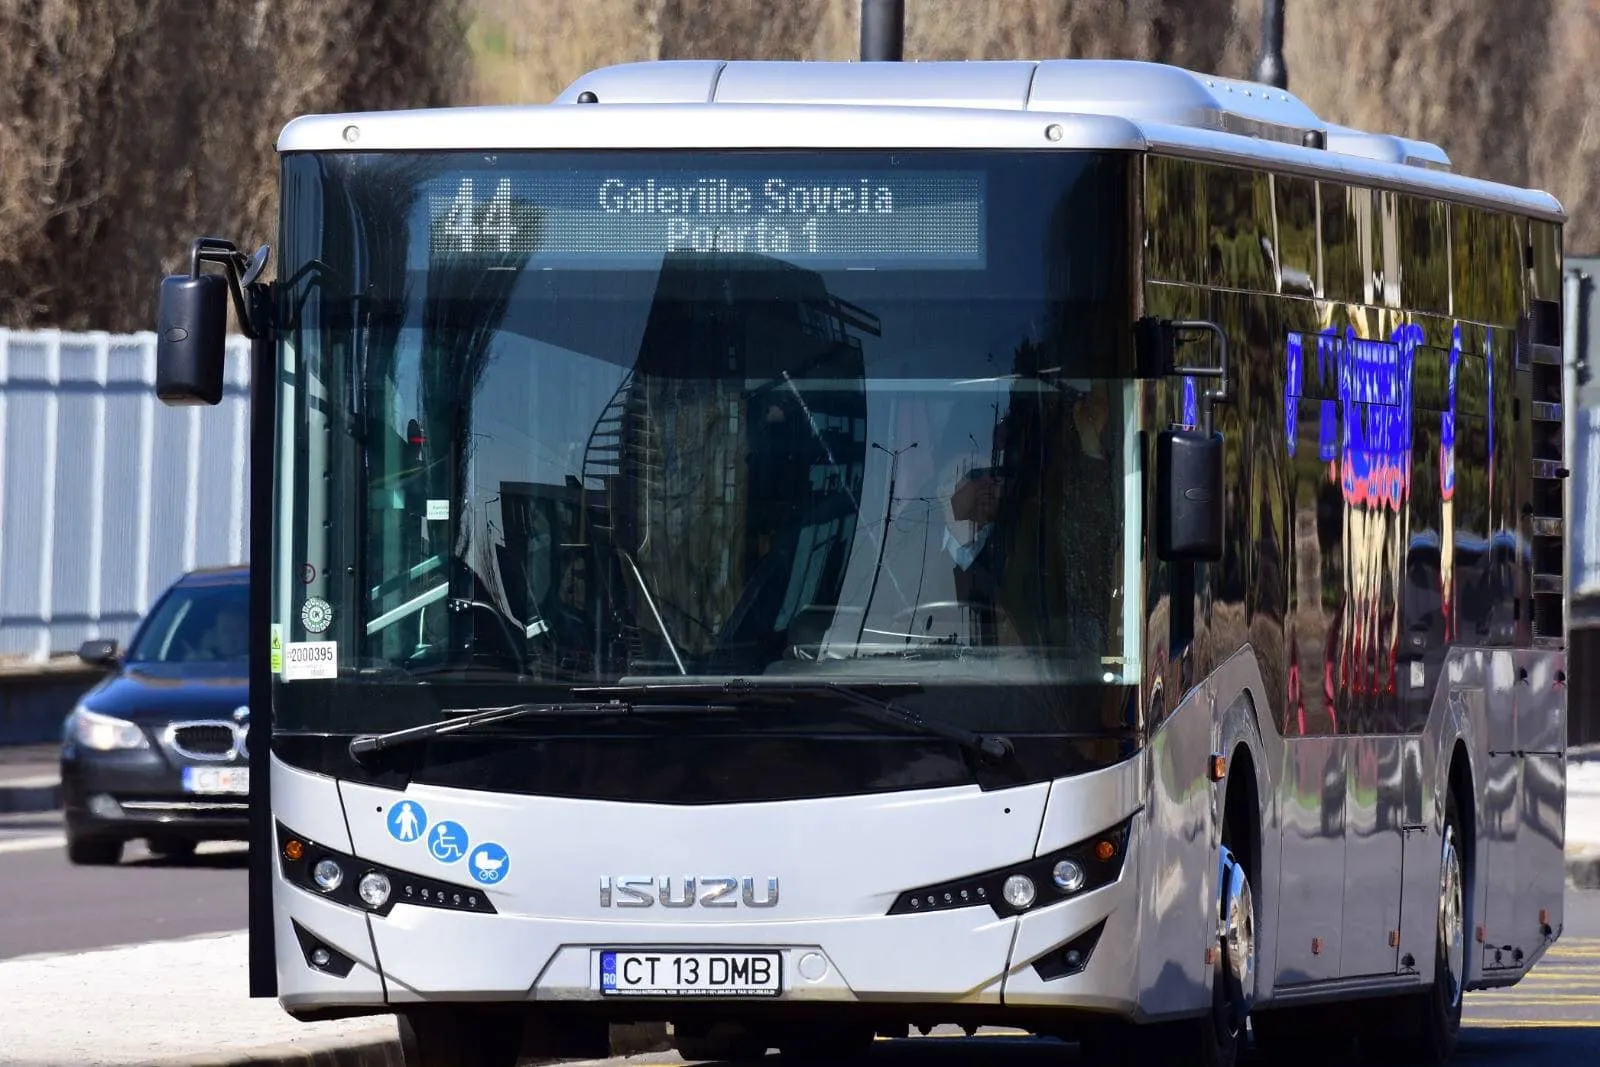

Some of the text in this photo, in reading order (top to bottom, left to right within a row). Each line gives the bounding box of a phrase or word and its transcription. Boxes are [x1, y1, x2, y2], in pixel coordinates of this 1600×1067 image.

[445, 178, 893, 252] 44 Galeriile Soveja
[667, 217, 817, 252] Poarta 1
[291, 646, 333, 662] 2000395
[599, 875, 779, 908] ISUZU
[602, 957, 771, 985] RO CT 13 DMB
